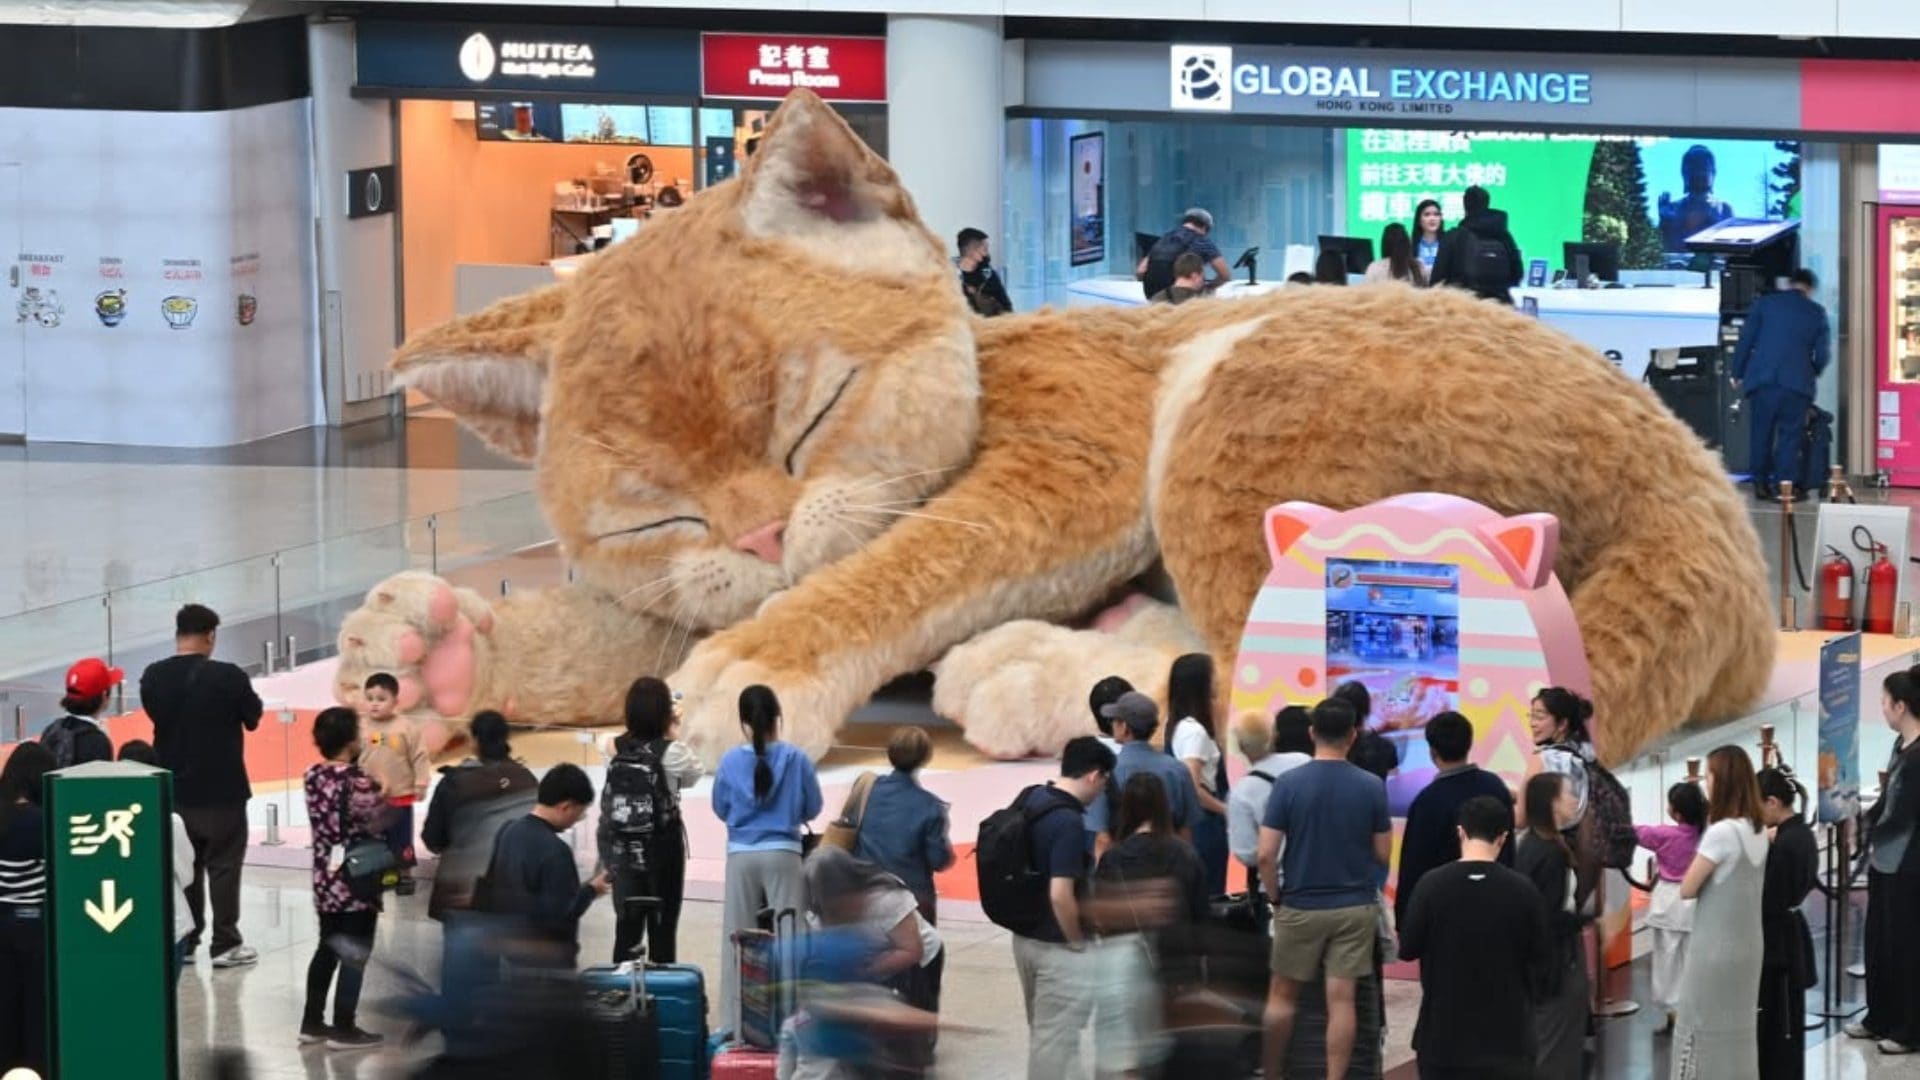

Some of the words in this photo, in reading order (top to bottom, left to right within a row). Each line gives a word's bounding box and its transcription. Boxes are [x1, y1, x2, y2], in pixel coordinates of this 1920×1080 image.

[759, 45, 829, 68] 記者室
[749, 69, 791, 86] Press
[792, 71, 839, 87] Room
[1234, 65, 1380, 98] GLOBAL
[1390, 69, 1591, 104] EXCHANGE
[1316, 100, 1352, 111] HONG
[1359, 101, 1395, 112] KONG
[1402, 102, 1454, 114] LIMITED
[1360, 163, 1507, 187] 前往天壇大佛的
